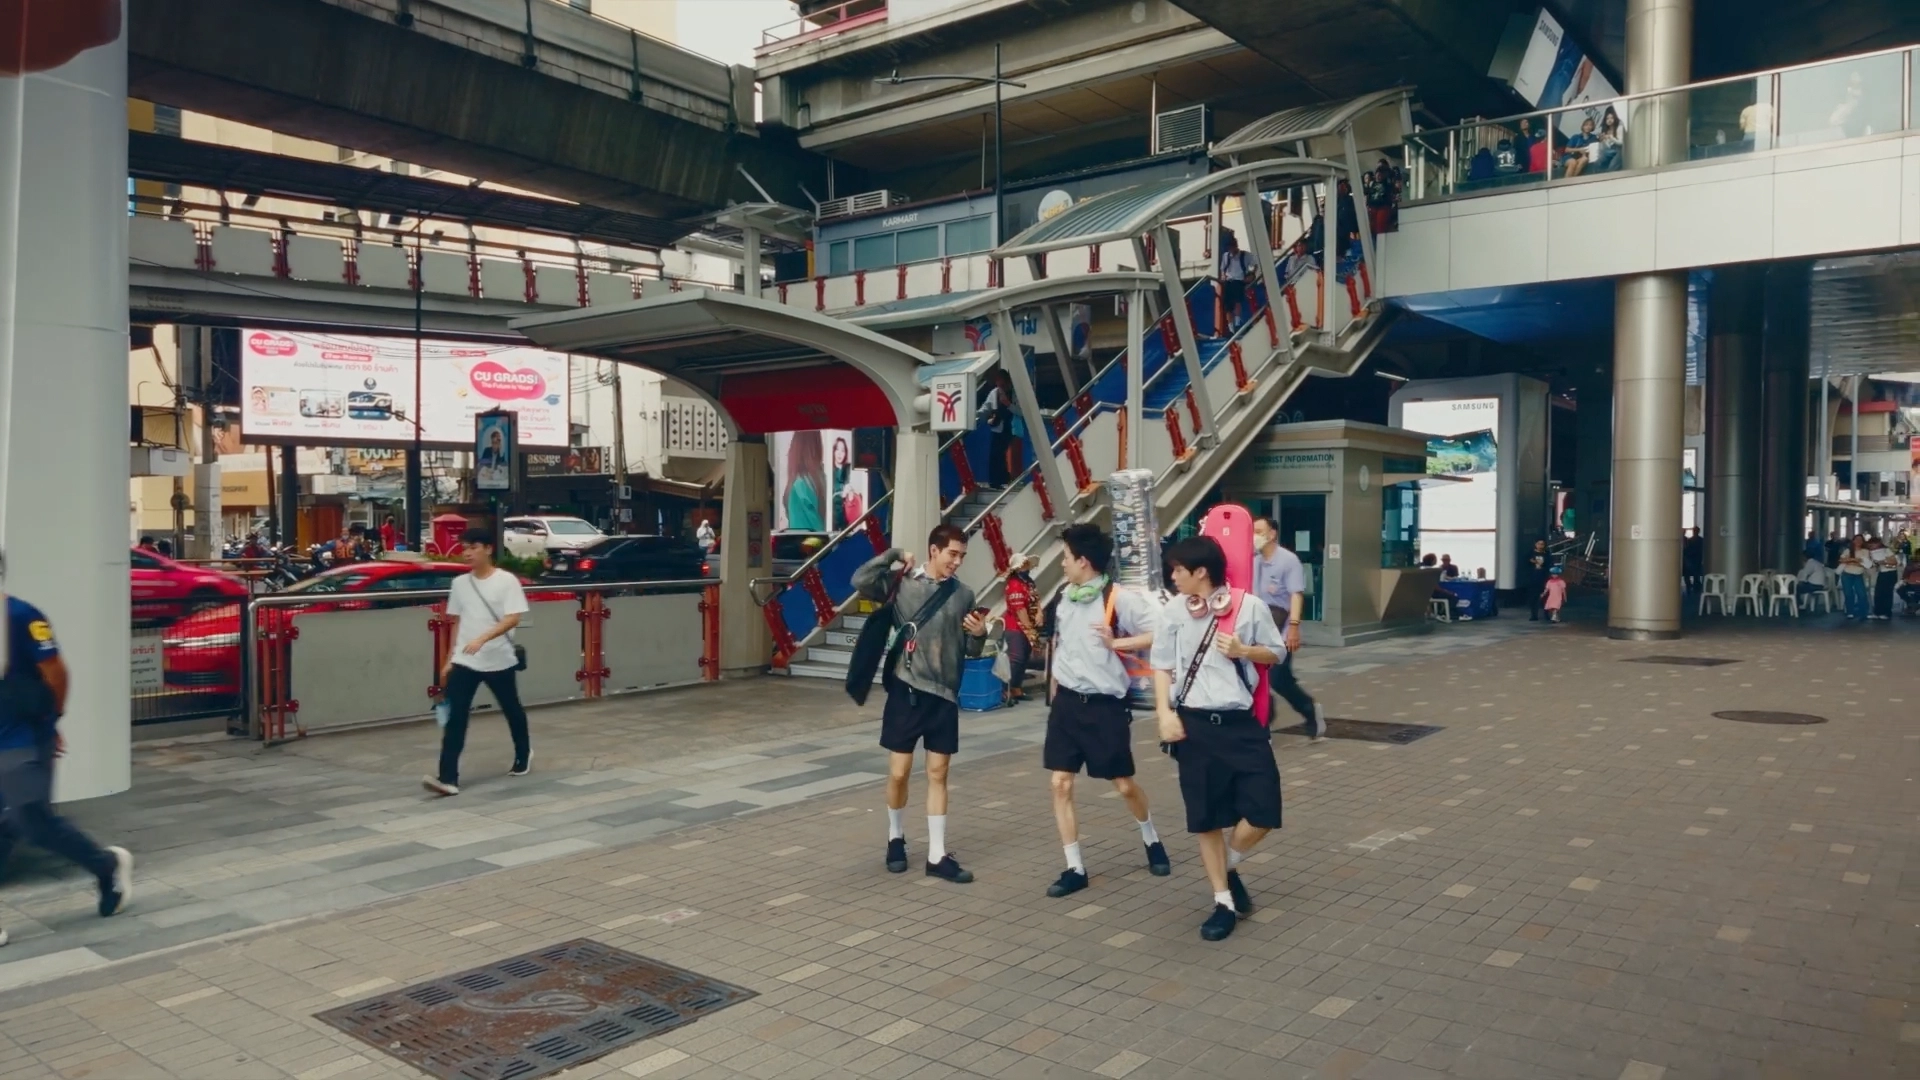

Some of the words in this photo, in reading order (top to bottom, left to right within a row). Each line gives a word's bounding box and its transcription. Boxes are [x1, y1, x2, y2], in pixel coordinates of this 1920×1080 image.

[1539, 20, 1559, 47] SAMSUNG
[882, 213, 919, 228] KARMART
[474, 371, 491, 382] CU
[493, 373, 539, 385] GRADS!
[481, 381, 492, 389] The
[492, 382, 511, 390] Future
[1451, 402, 1495, 411] SAMSUNG
[527, 454, 561, 467] assage
[1285, 454, 1334, 464] INFORMATION
